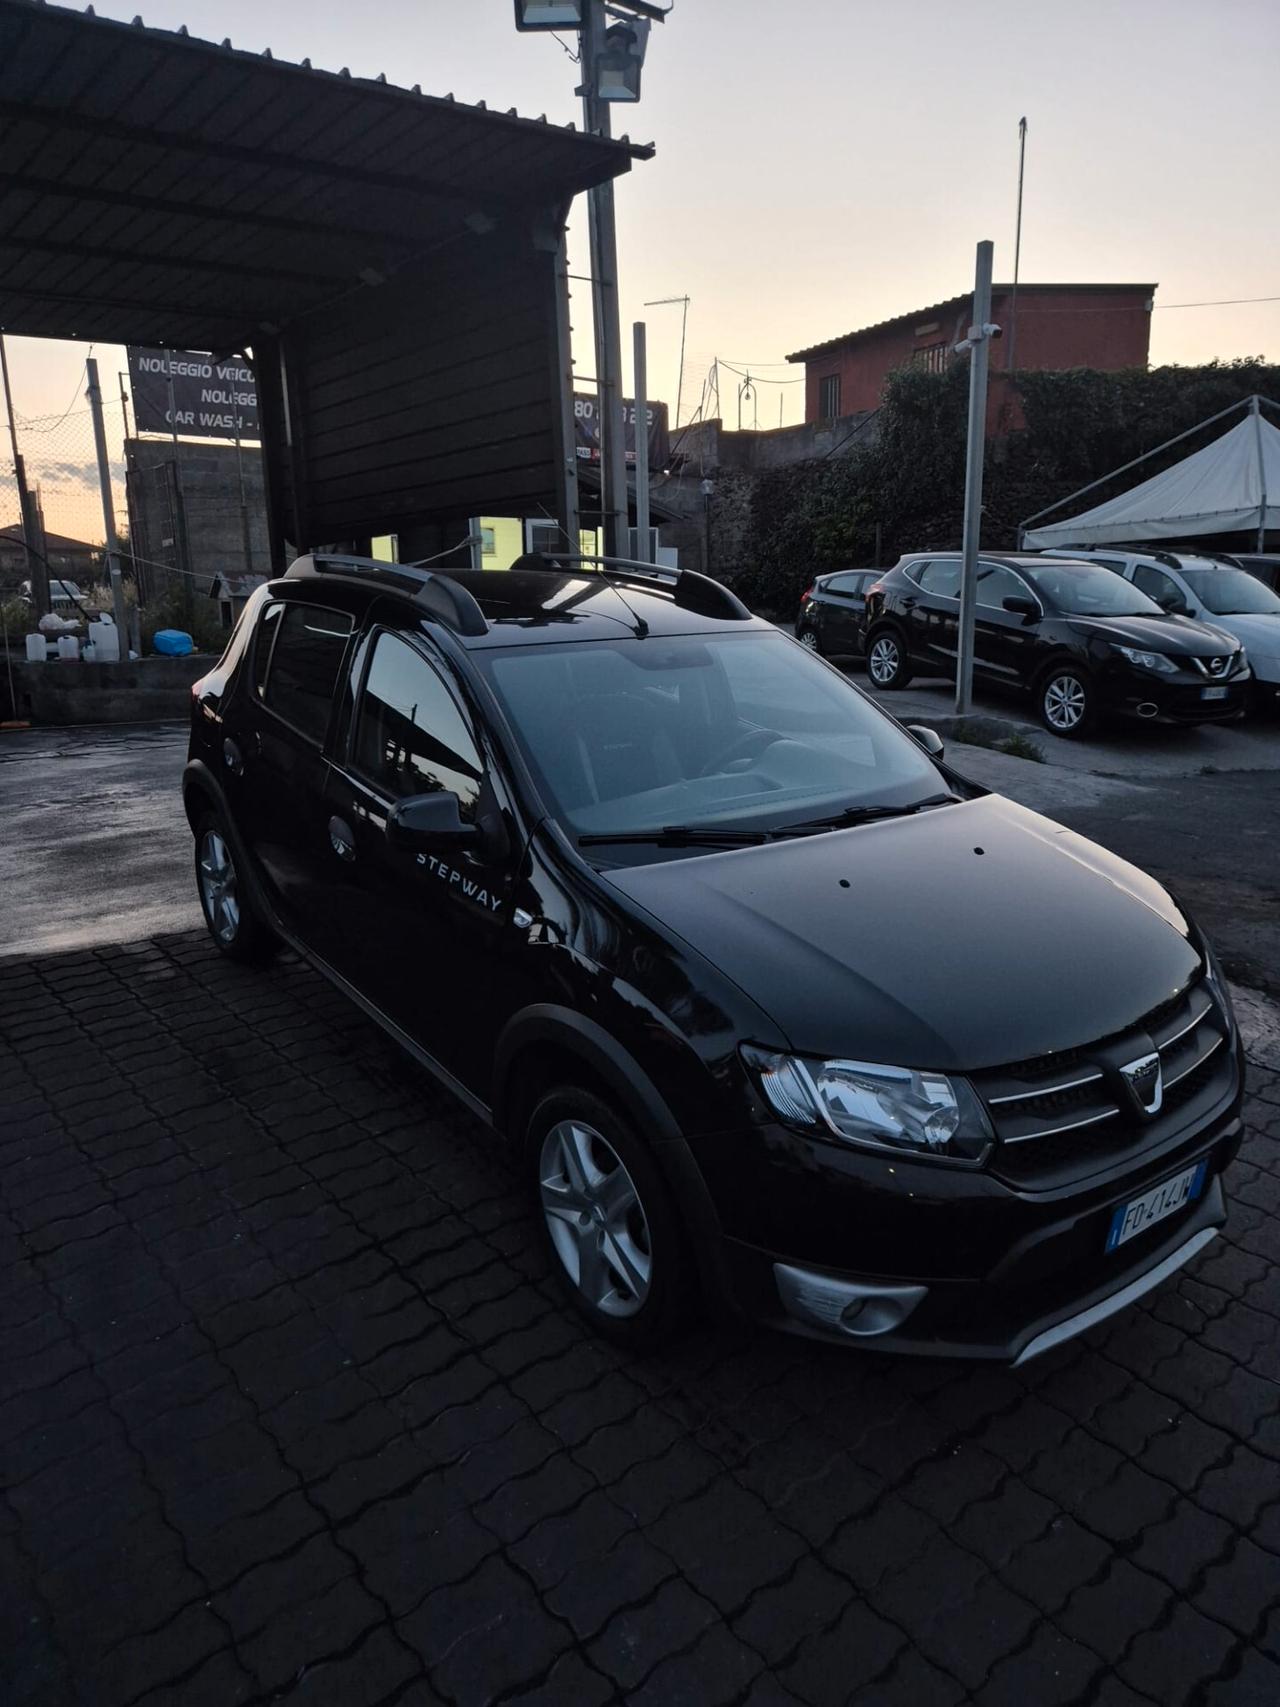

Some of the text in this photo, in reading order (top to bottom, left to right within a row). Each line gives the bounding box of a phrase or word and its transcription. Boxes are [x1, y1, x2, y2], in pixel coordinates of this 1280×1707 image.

[138, 357, 213, 379] NOLEGGIO
[165, 410, 195, 425] CAR
[199, 412, 243, 429] WASH
[416, 852, 502, 912] STEPWAY
